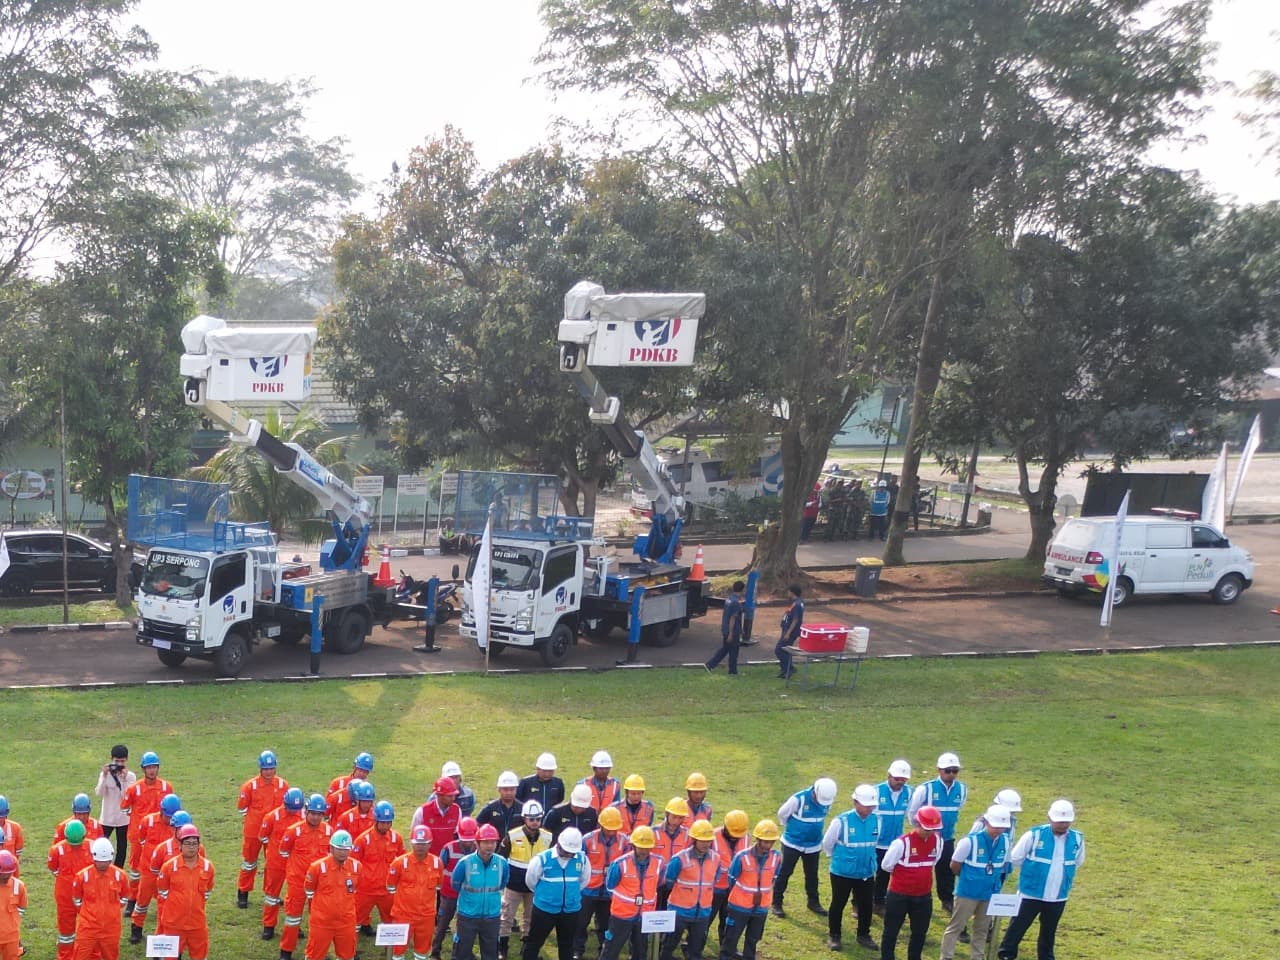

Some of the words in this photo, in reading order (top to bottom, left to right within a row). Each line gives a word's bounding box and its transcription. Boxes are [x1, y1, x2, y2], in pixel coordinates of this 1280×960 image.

[629, 348, 678, 362] PDKB
[253, 383, 283, 392] PDKB
[166, 555, 200, 568] SERPONG
[1051, 552, 1084, 564] AMBULANCE
